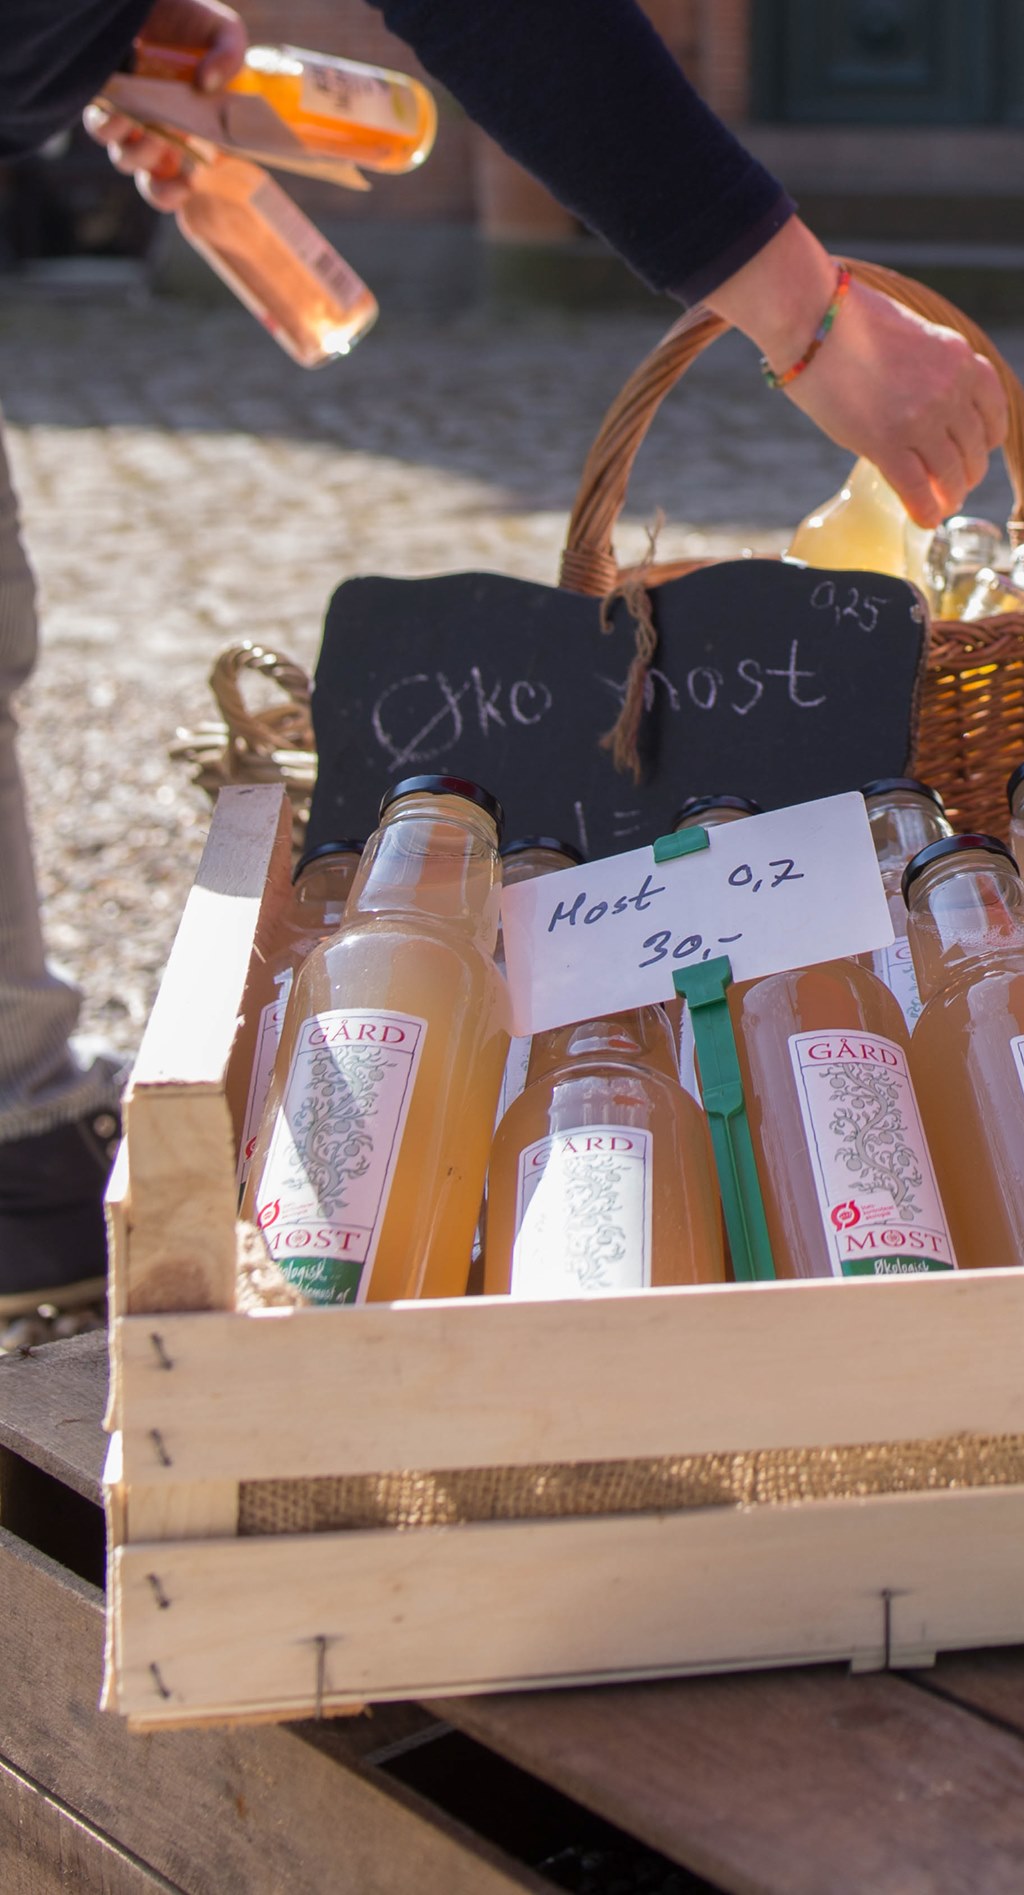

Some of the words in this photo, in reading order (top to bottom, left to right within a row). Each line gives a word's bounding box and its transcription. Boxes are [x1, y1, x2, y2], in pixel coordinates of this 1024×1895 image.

[810, 580, 887, 633] 0,25
[372, 666, 553, 772] Øko
[547, 875, 666, 932] Most
[728, 859, 804, 893] 0,7
[638, 930, 743, 968] 30,-
[308, 1017, 406, 1046] GÅRD
[807, 1038, 899, 1067] GÅRD
[531, 1134, 634, 1168] GÅRD
[846, 1229, 943, 1253] MOST
[279, 1257, 327, 1286] ologisk
